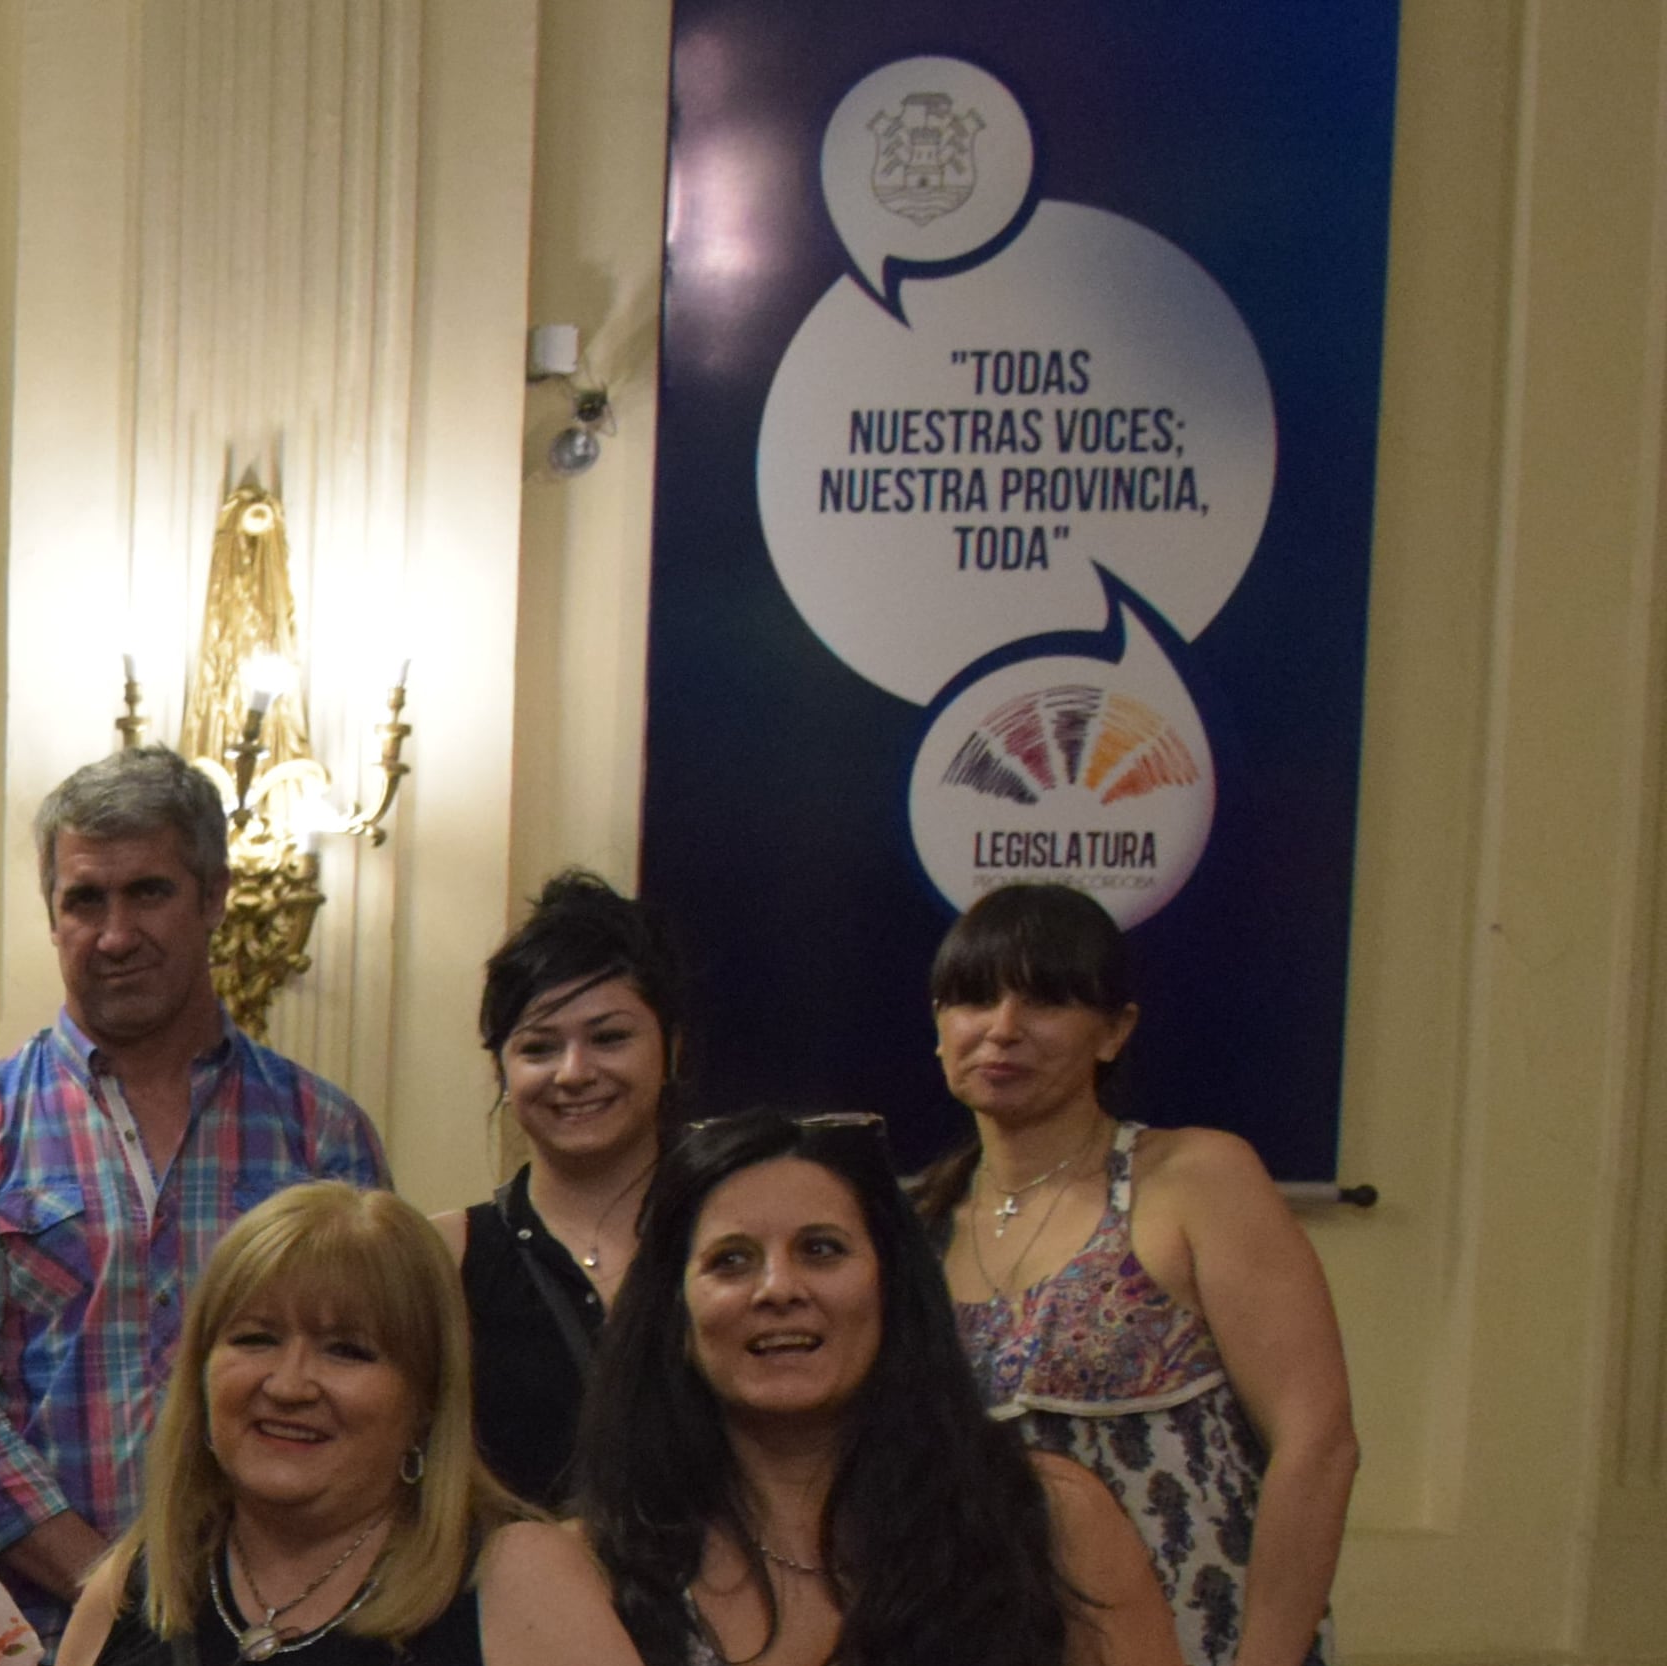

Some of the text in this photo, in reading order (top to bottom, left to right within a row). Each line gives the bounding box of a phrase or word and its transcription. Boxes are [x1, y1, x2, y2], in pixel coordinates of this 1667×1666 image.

[950, 350, 1091, 396] "TODAS
[848, 408, 1186, 459] NUESTRAS VOCES;
[818, 467, 1210, 518] NUESTRA PROVINCIA,
[953, 525, 1071, 572] TODA"
[973, 831, 1157, 869] LEGISLATURA
